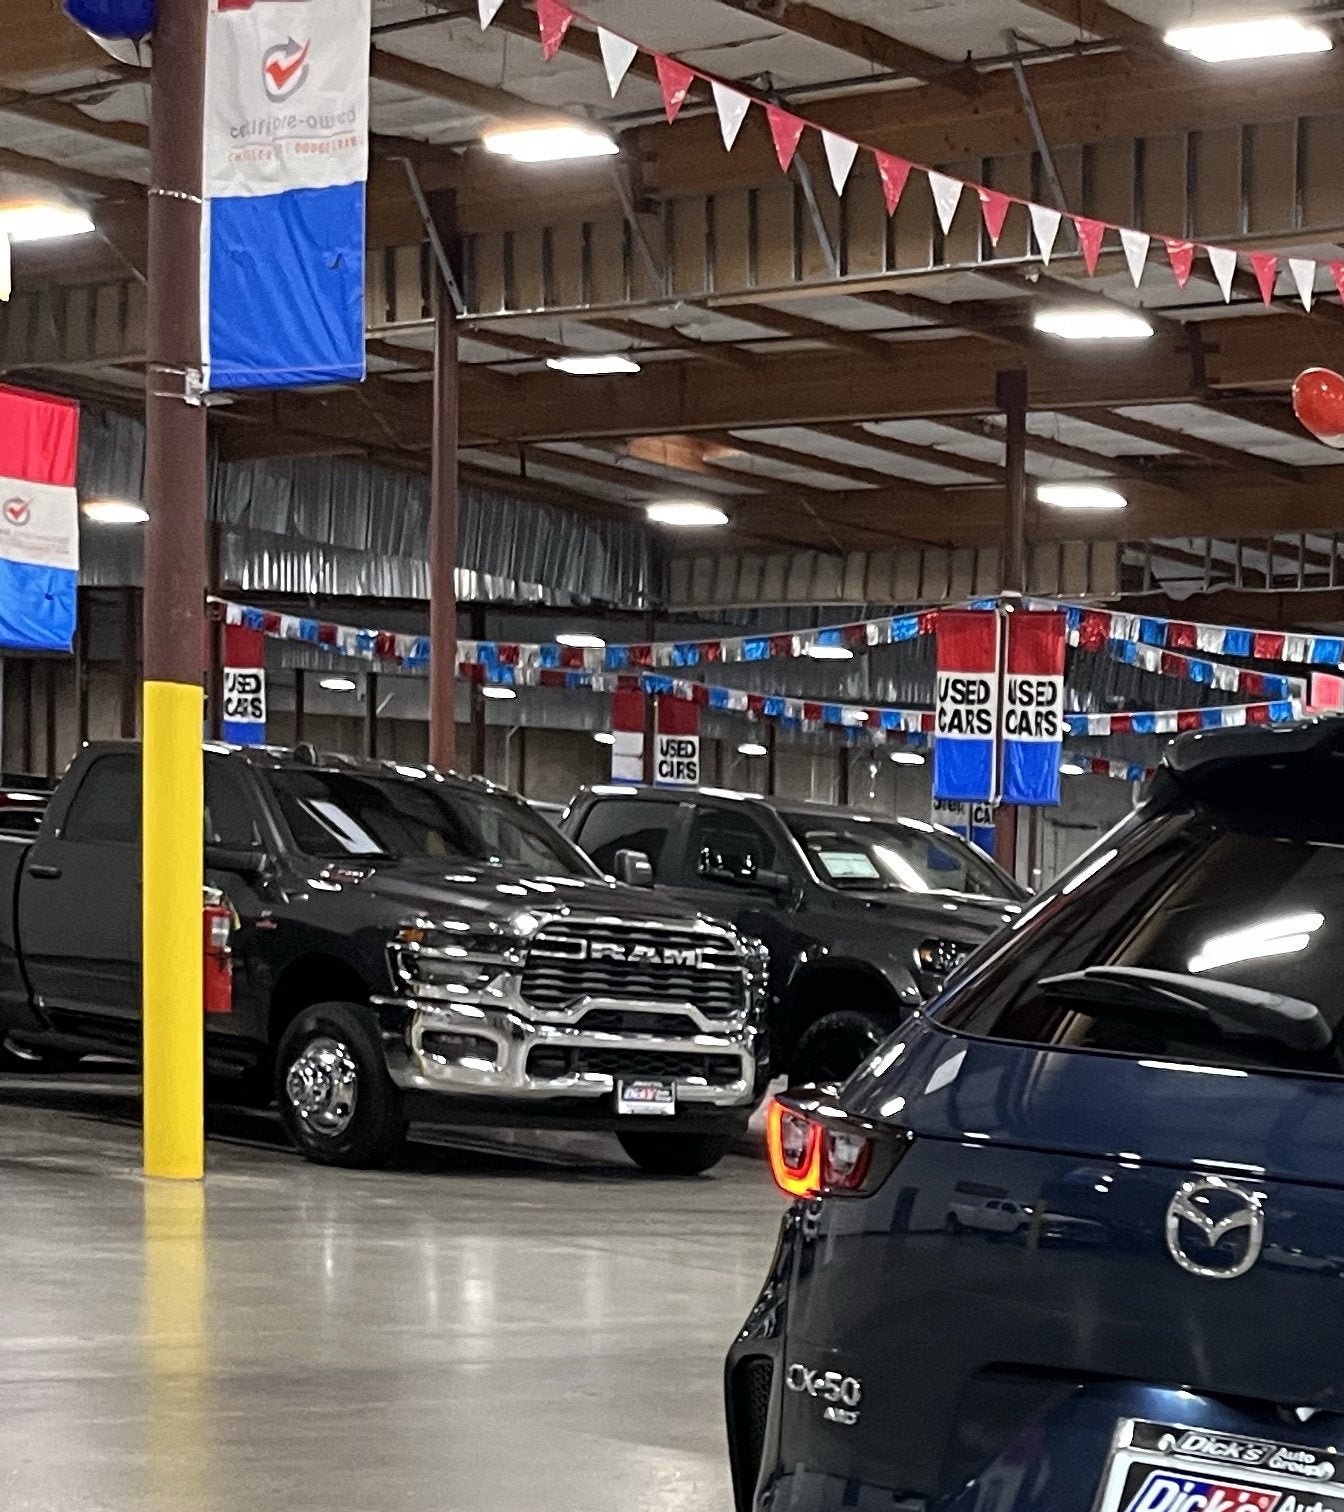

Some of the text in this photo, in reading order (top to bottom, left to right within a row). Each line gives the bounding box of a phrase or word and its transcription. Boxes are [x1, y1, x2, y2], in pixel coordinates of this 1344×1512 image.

[938, 677, 990, 705] USED
[1008, 679, 1057, 706] USED
[938, 706, 992, 734] CARS
[1005, 709, 1057, 736] CARS
[660, 739, 696, 758] USED
[590, 942, 696, 966] RAM
[1181, 1435, 1316, 1464] Dick's Auto
